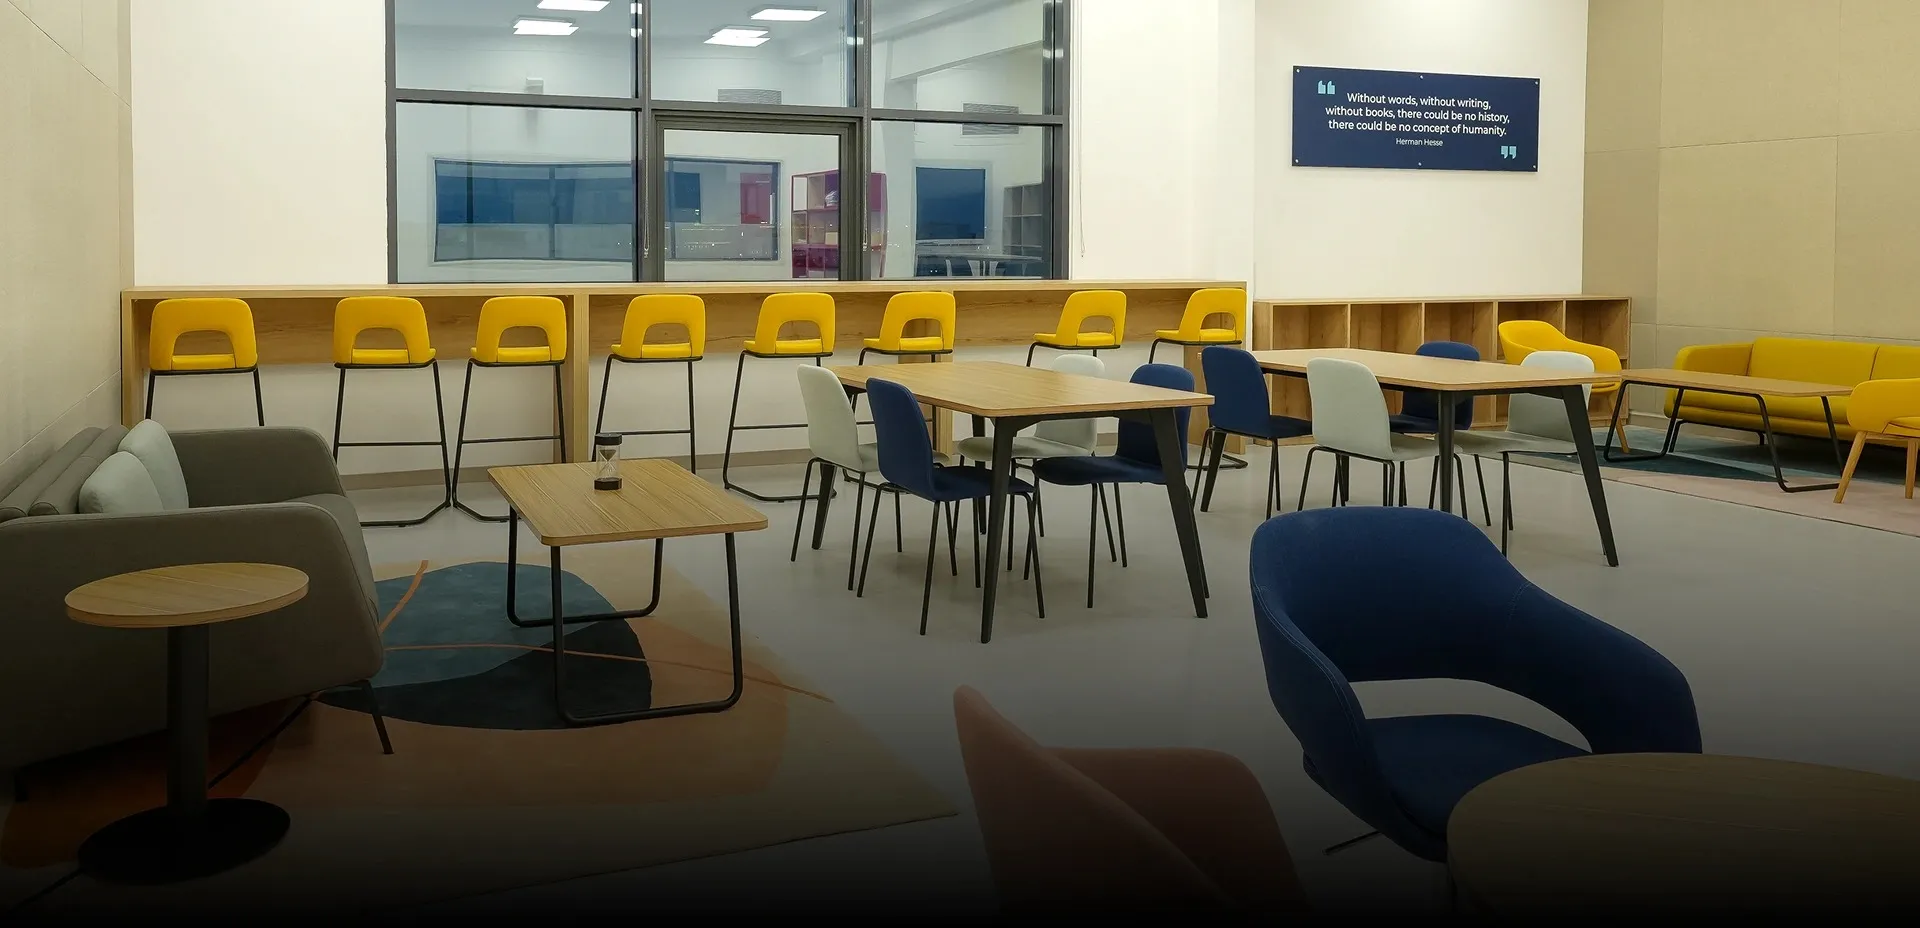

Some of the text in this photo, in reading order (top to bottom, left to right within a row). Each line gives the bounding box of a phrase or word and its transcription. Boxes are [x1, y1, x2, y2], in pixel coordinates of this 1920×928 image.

[1347, 93, 1491, 110] Without words, without writing,
[1326, 107, 1364, 116] without
[1365, 108, 1396, 119] books,
[1397, 110, 1422, 119] there
[1424, 111, 1449, 120] could
[1451, 111, 1462, 120] be
[1478, 113, 1510, 123] history,
[1329, 120, 1507, 136] there could be no concept of humanity.
